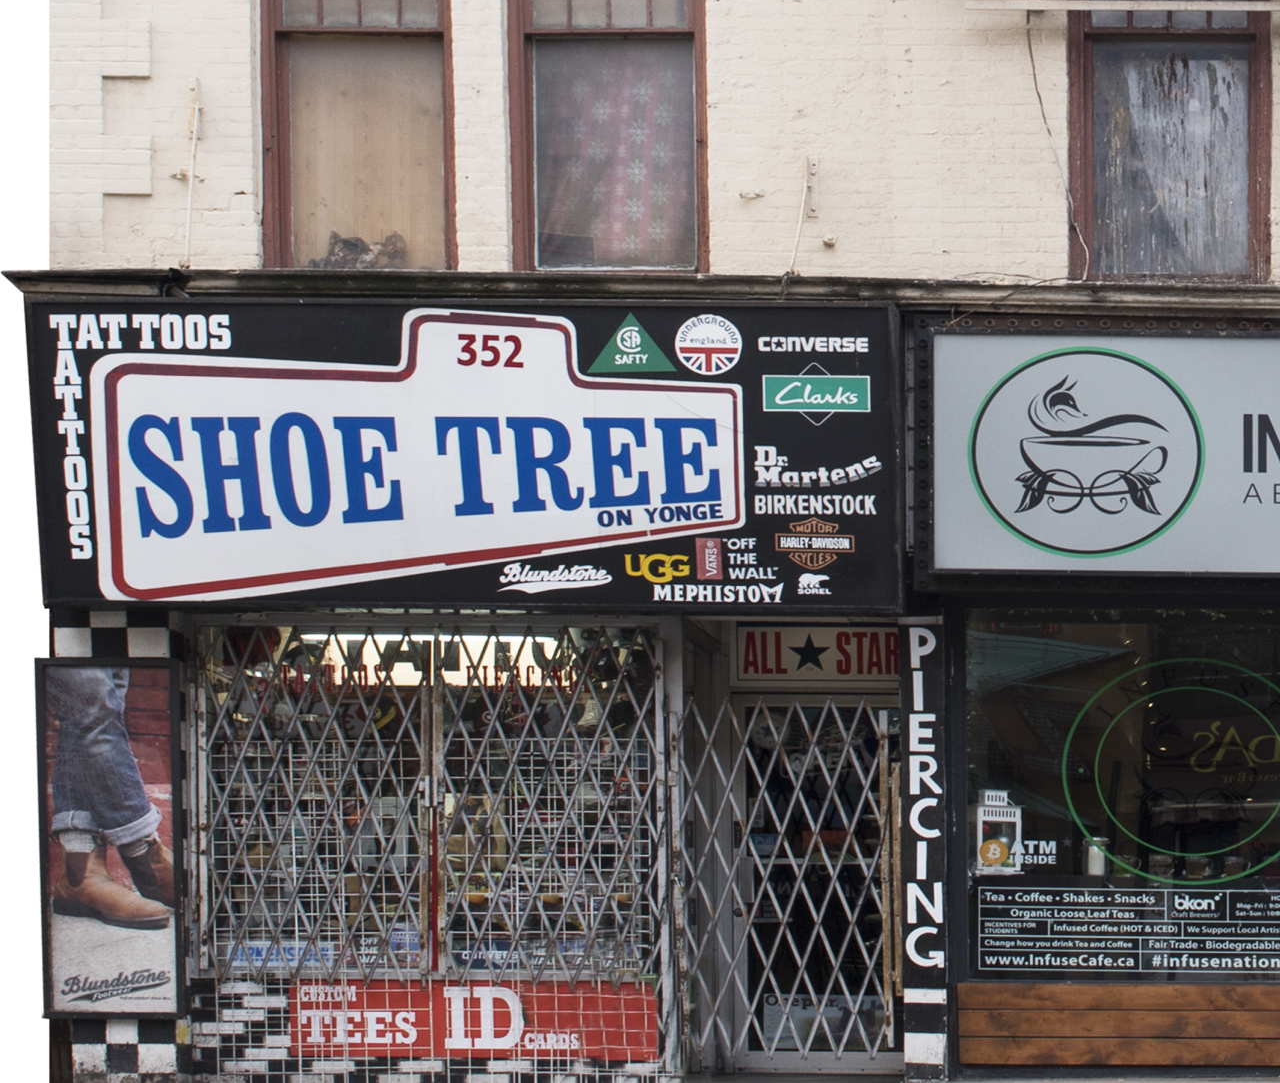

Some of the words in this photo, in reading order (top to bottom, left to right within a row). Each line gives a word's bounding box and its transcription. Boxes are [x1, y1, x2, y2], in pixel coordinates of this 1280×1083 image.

[49, 314, 232, 350] TATTOOS
[678, 316, 739, 345] UNDERGROUND
[689, 335, 728, 346] england
[758, 336, 869, 353] CONVERSE
[457, 333, 525, 369] 352
[614, 353, 648, 365] SAFTY
[774, 381, 858, 405] Clarks
[754, 445, 789, 466] Dr.
[127, 413, 403, 539] SHOE
[436, 416, 722, 517] TREE
[754, 455, 882, 488] Martens
[1242, 483, 1263, 505] A
[754, 494, 877, 515] BIRKENSTOCK
[597, 509, 633, 528] ON
[644, 503, 724, 525] YONGE
[796, 521, 834, 533] MOTOR
[780, 536, 850, 550] HARLEY-DAVIDSON
[727, 553, 757, 565] THE
[794, 552, 832, 567] CYCLES
[499, 562, 612, 586] Blundstone
[624, 554, 690, 583] UGG
[743, 631, 788, 675] ALL
[836, 631, 899, 675] STAR
[905, 627, 945, 968] PIERCING
[754, 835, 774, 844] Pull
[1010, 840, 1057, 854] ATM
[984, 892, 1005, 902] Tea
[1015, 892, 1053, 903] Coffee
[1063, 893, 1105, 904] Shakes
[1114, 894, 1156, 905] Snacks
[1174, 894, 1216, 911] bkon
[1010, 908, 1052, 920] Organic
[1054, 909, 1085, 919] Loose
[1087, 909, 1110, 919] Leaf
[1112, 910, 1135, 919] Teas
[1053, 923, 1088, 933] Infused
[1089, 924, 1118, 933] Coffee
[1120, 924, 1143, 934] (HOT
[1145, 925, 1152, 933] &
[1153, 925, 1178, 935] ICED)
[1187, 926, 1199, 934] We
[1201, 925, 1235, 936] Support
[1237, 926, 1258, 934] Local
[984, 939, 1015, 949] Change
[1017, 939, 1033, 948] how
[1035, 941, 1051, 949] you
[1052, 939, 1073, 948] drink
[1075, 940, 1088, 948] Tea
[1090, 940, 1105, 948] and
[1107, 940, 1133, 948] Coffee
[1149, 940, 1167, 949] Fair
[1169, 940, 1198, 949] Trade
[1206, 940, 1280, 952] Biodegradable
[985, 954, 1134, 967] www.InfuseCafe.ca
[1151, 954, 1280, 968] #infusenation
[61, 968, 171, 996] Blundstone
[300, 985, 357, 1002] CUSTOM
[443, 986, 525, 1049] ID
[524, 1032, 579, 1049] CARDS
[301, 1011, 418, 1045] TEES
